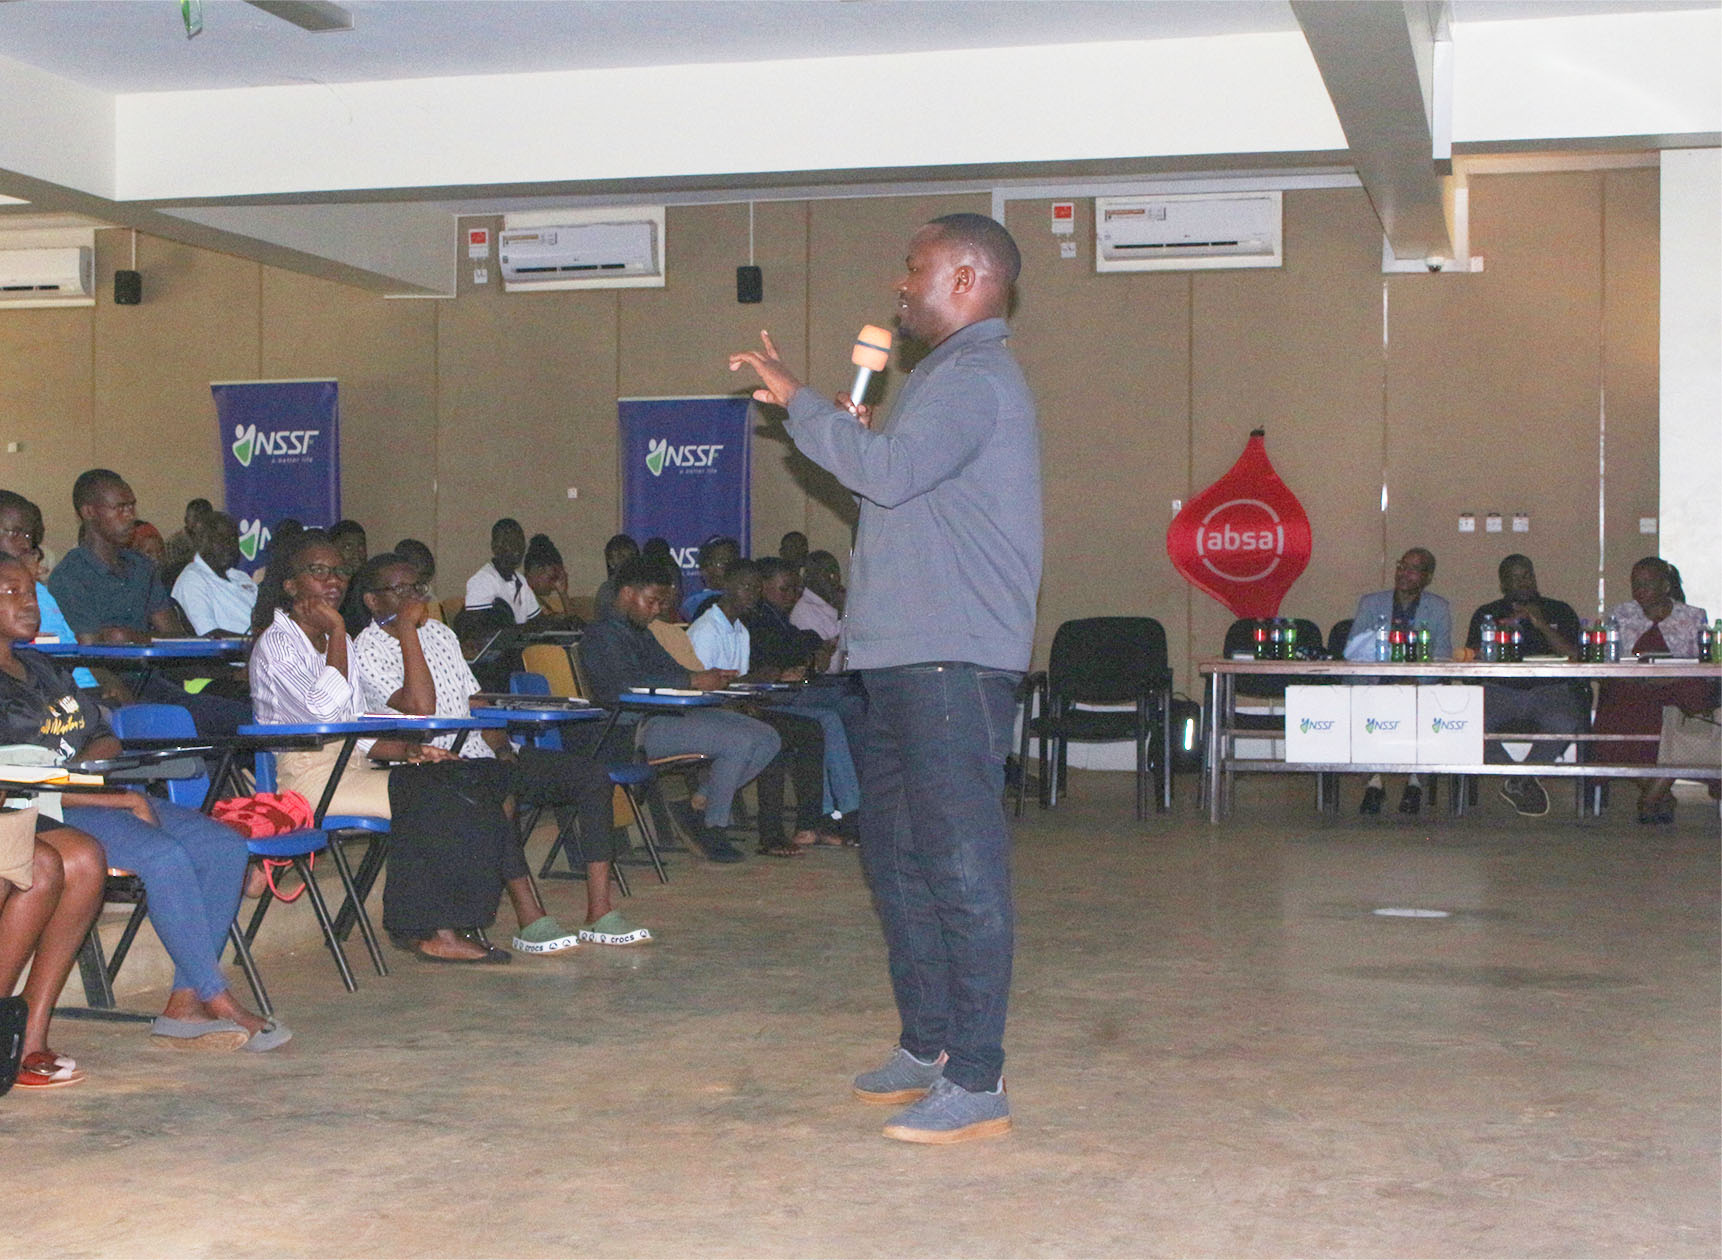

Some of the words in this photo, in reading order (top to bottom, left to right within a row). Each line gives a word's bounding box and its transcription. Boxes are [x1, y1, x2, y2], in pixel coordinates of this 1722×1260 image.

[254, 430, 320, 456] NSSF
[664, 445, 724, 467] NSSF
[1207, 523, 1274, 550] absa
[1308, 720, 1335, 730] NSSF
[1374, 720, 1400, 730] NSSF
[1441, 720, 1468, 730] NSSF
[611, 935, 635, 944] crocs
[524, 943, 544, 952] crocs
